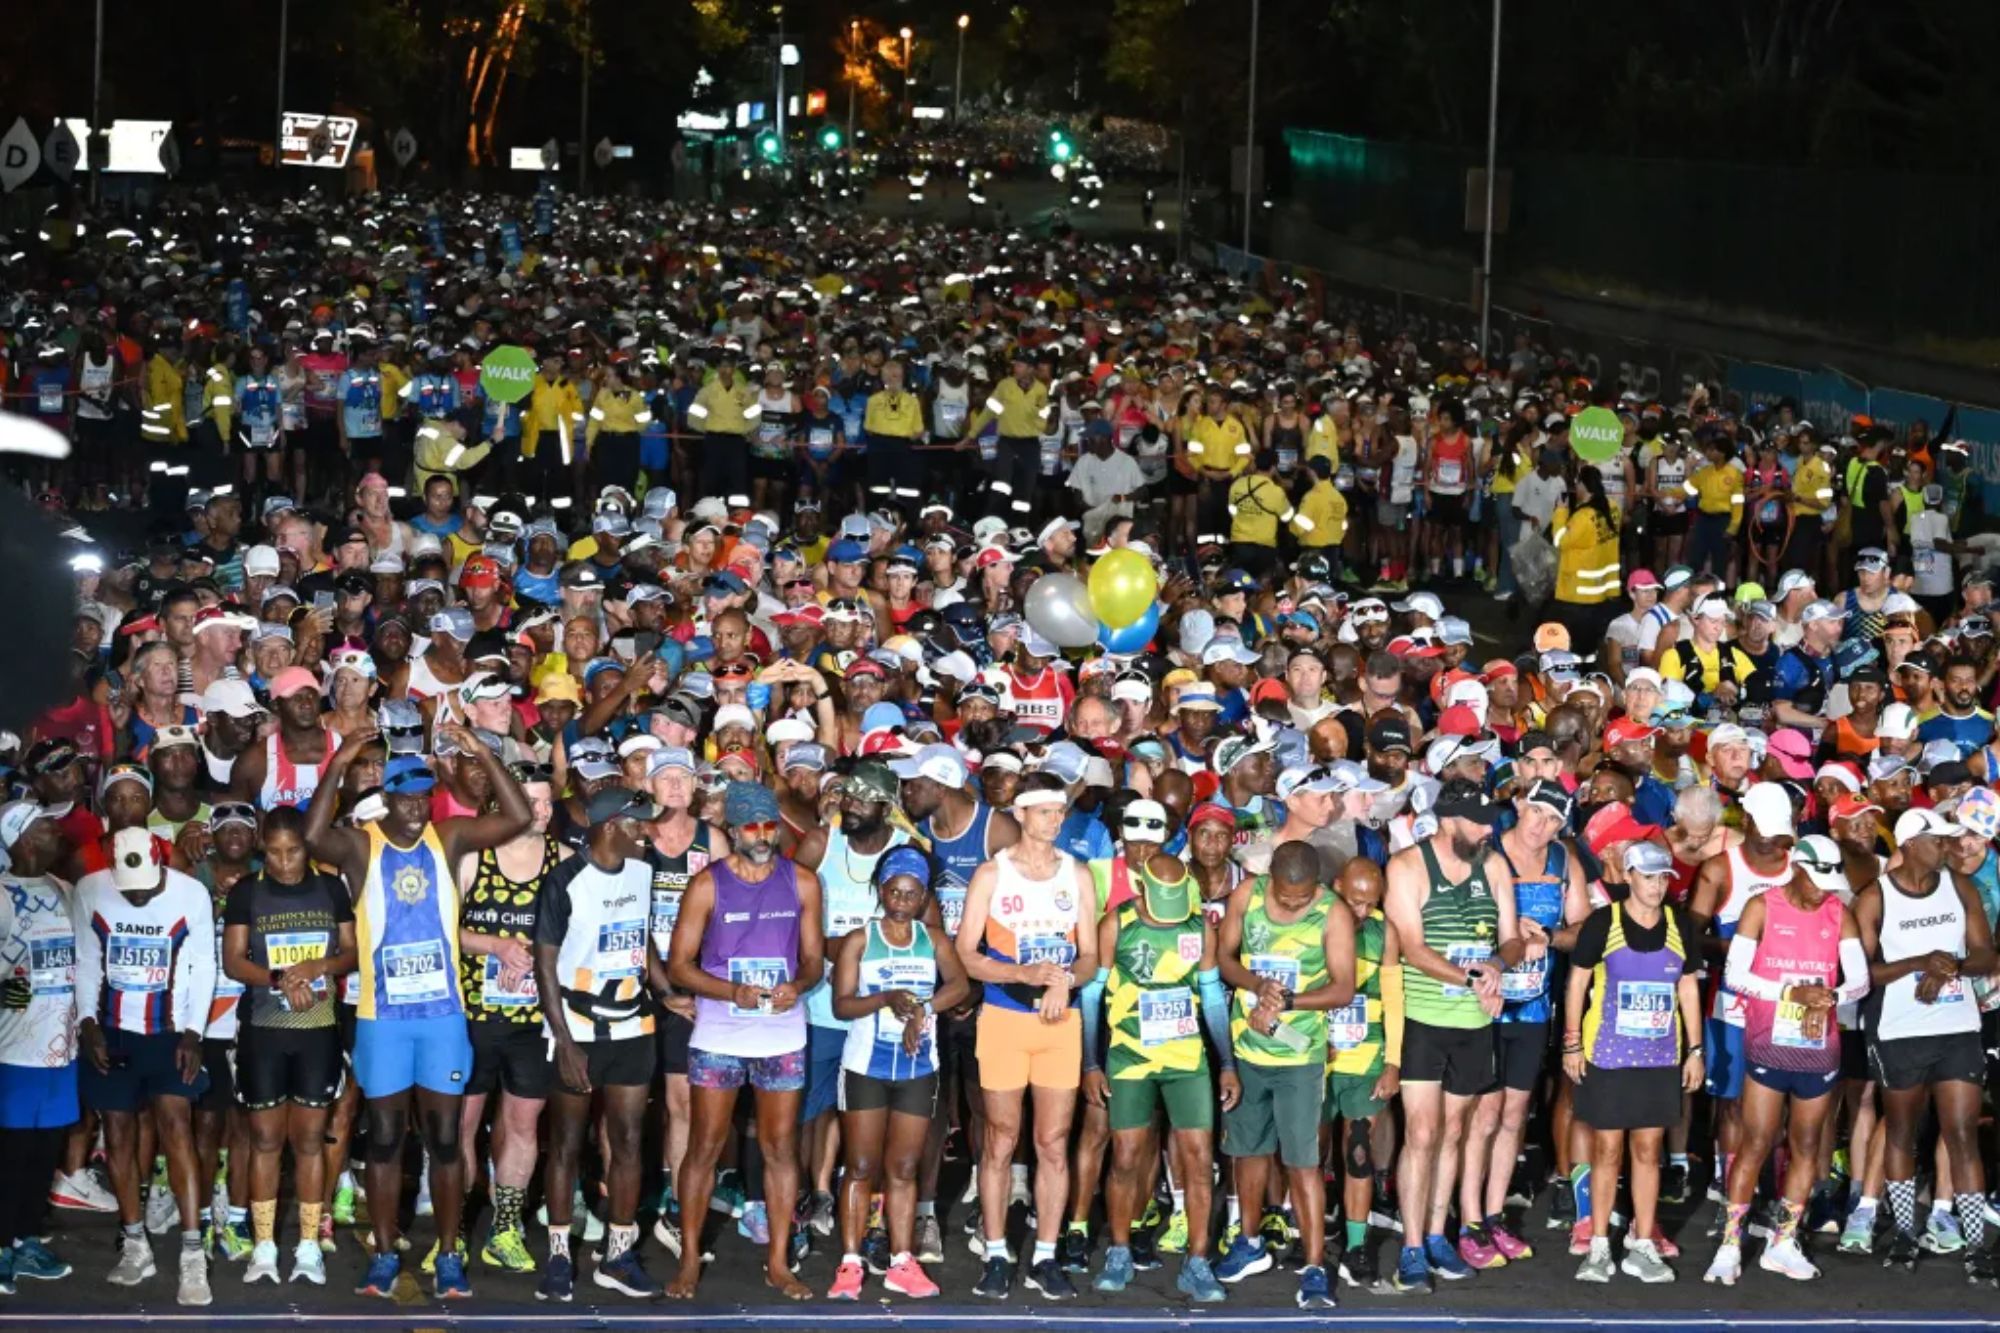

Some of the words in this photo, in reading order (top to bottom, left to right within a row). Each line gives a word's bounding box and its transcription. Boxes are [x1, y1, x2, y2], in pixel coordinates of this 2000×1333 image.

[55, 141, 70, 162] E
[398, 140, 410, 153] H
[5, 144, 28, 168] D
[485, 365, 532, 381] WALK
[1574, 425, 1619, 442] WALK
[1001, 894, 1025, 915] 50
[115, 922, 164, 936] SANDF
[1899, 912, 1957, 931] RANDBURG
[604, 929, 641, 951] J5752
[1180, 936, 1200, 960] 65
[117, 947, 161, 966] J5159
[394, 954, 436, 977] J5702
[1766, 957, 1795, 970] TEAM
[145, 967, 166, 984] 70
[1150, 1000, 1187, 1020] J3259
[1628, 993, 1666, 1011] J5816
[1177, 1018, 1195, 1035] 60
[1652, 1011, 1669, 1027] 60
[1346, 1025, 1364, 1041] 50
